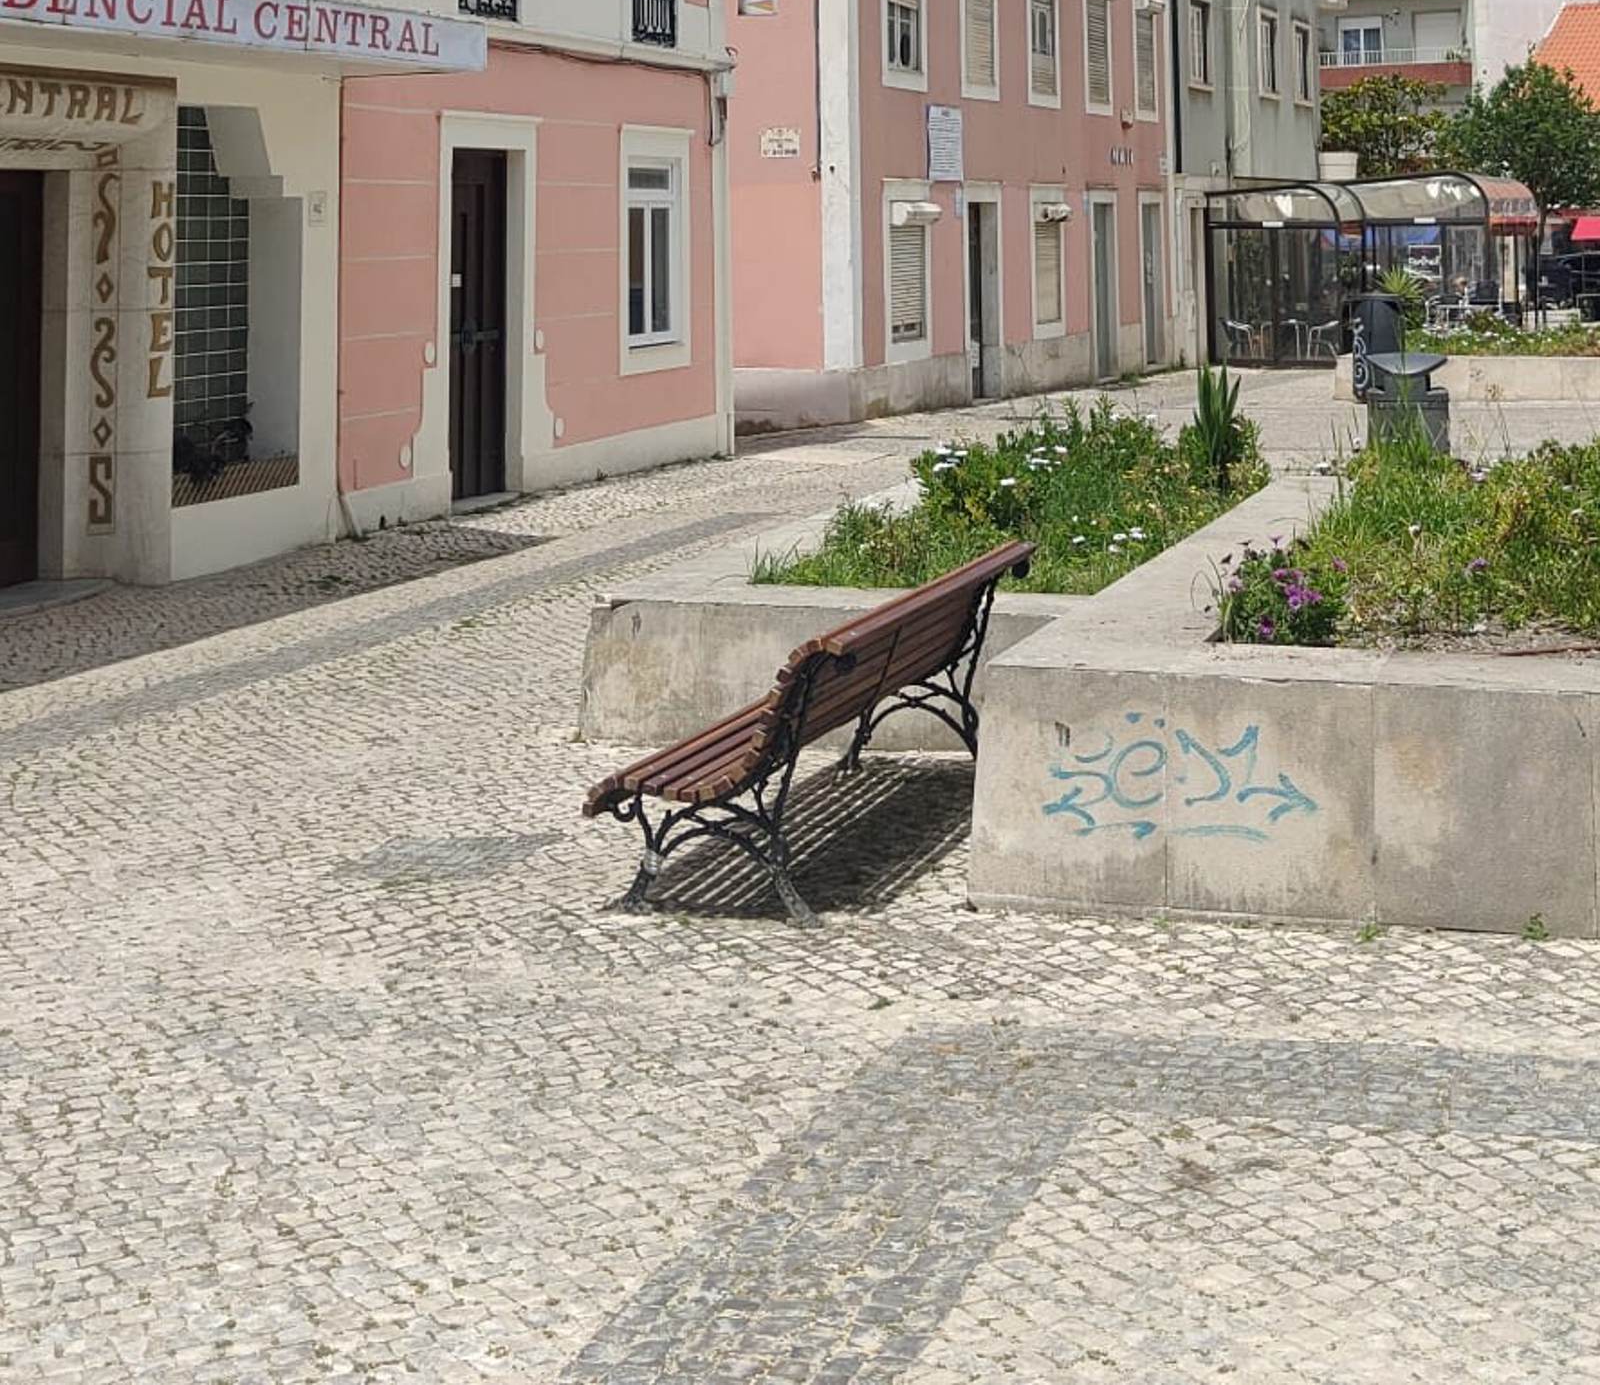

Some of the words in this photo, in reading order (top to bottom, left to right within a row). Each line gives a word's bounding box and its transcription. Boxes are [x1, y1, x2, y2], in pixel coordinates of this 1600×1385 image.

[253, 1, 440, 57] CENTRAL
[0, 78, 144, 125] NTRAL
[147, 180, 175, 399] HOTEL
